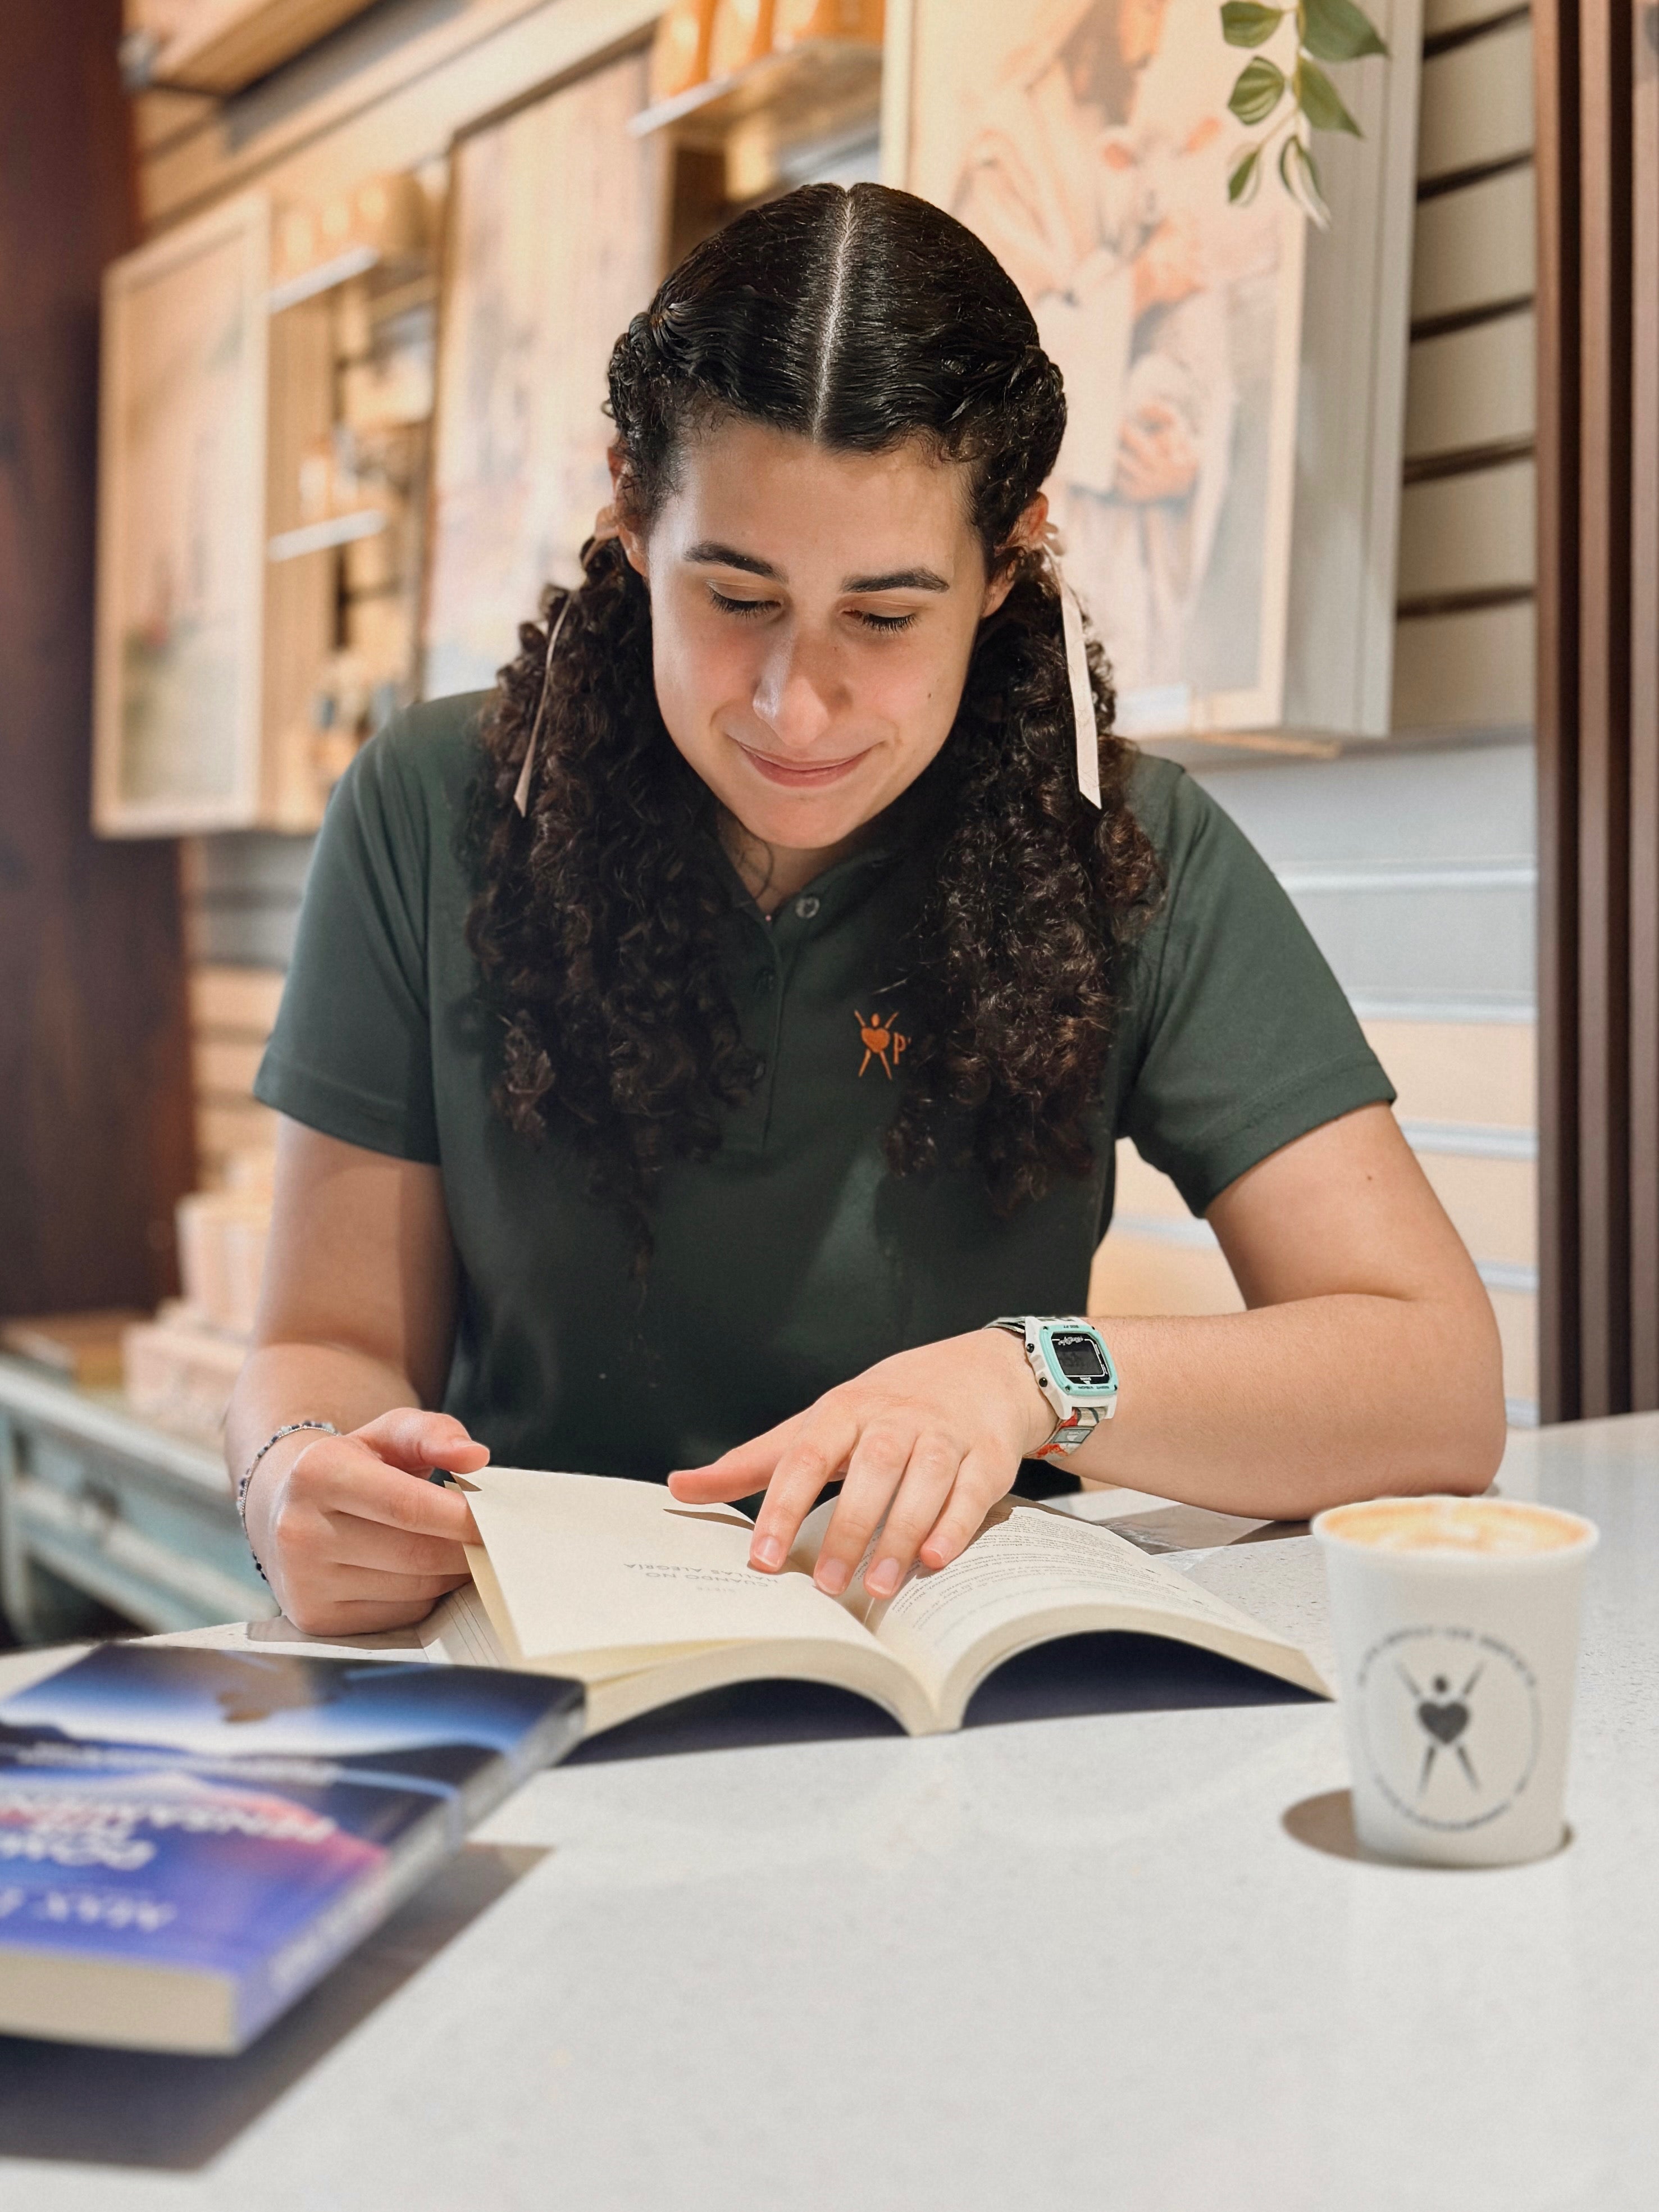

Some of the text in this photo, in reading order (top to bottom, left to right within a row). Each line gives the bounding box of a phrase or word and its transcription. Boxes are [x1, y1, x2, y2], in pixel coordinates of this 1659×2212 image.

[623, 1563, 778, 1583] HALLAS ALEGRÍA
[685, 1574, 768, 1587] CUANDO
